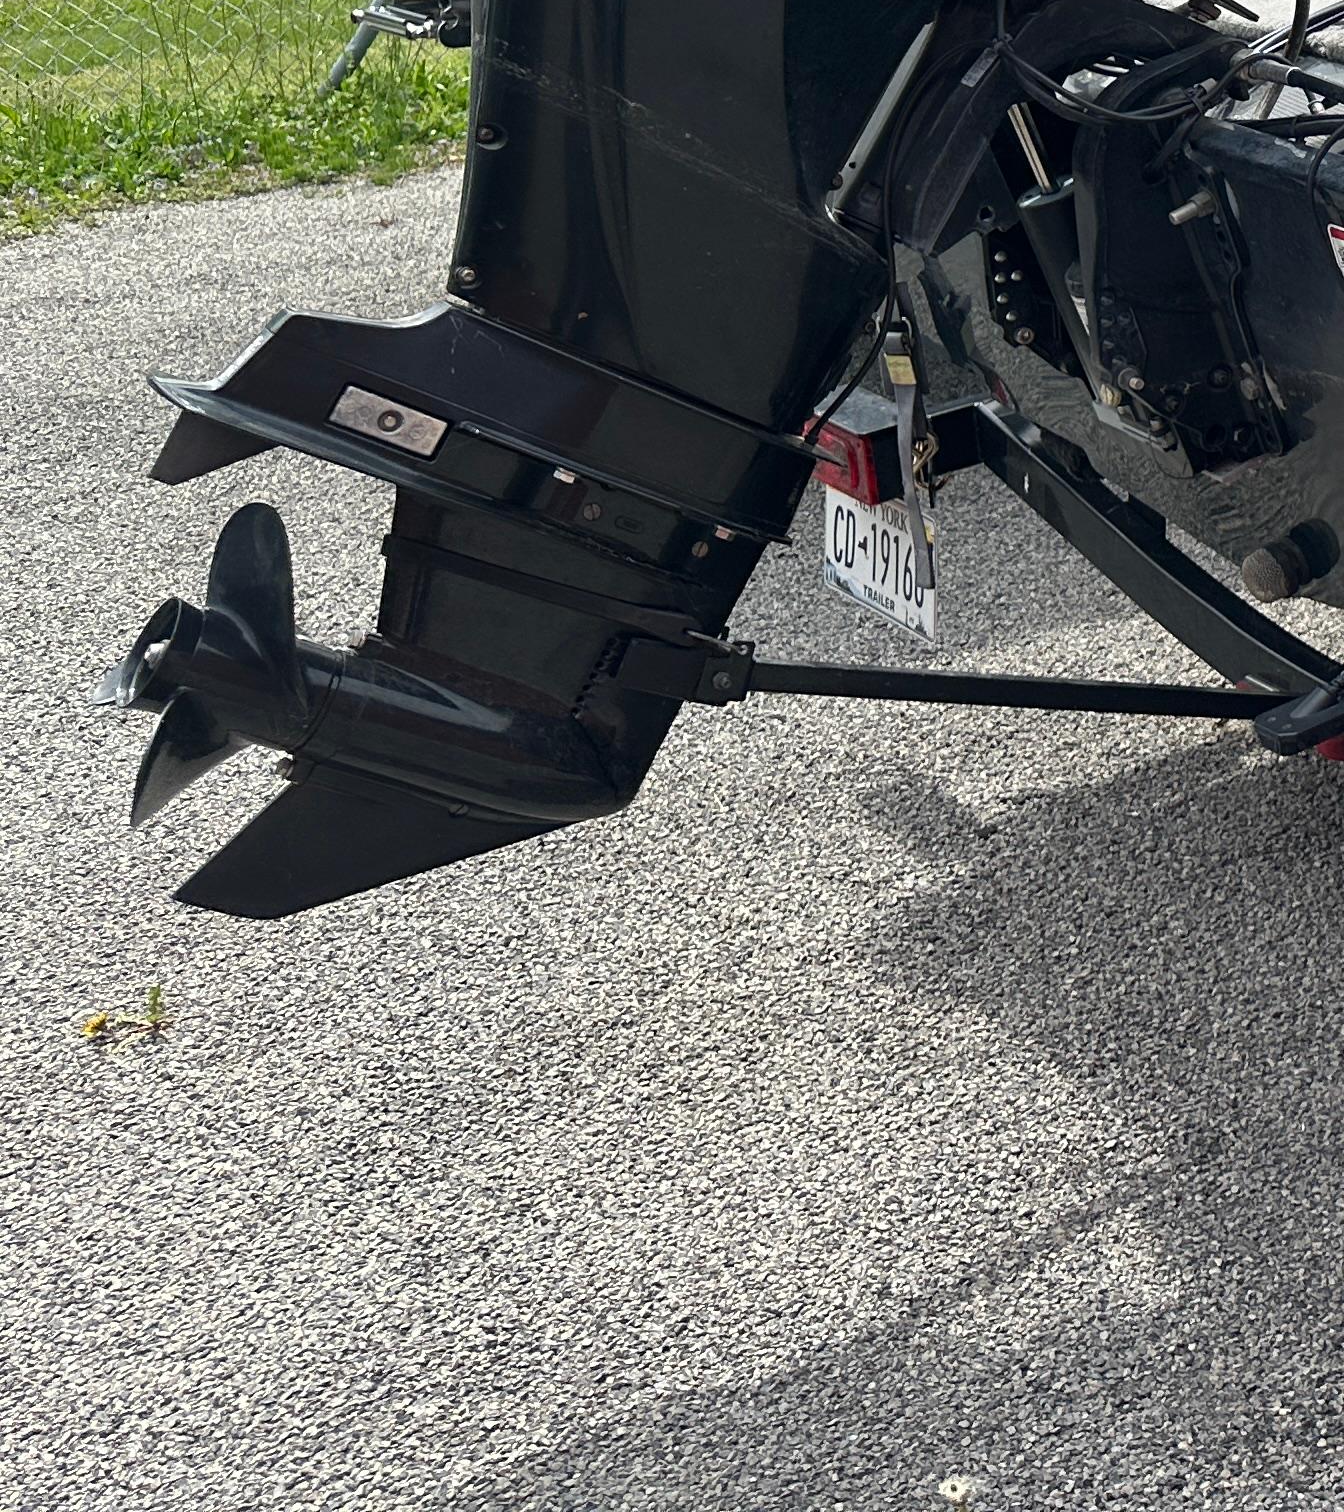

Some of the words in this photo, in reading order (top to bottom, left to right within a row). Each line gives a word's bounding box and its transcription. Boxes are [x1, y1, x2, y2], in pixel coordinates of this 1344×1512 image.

[880, 503, 909, 535] YORK
[833, 505, 857, 569] CD
[863, 584, 896, 614] TRAILER
